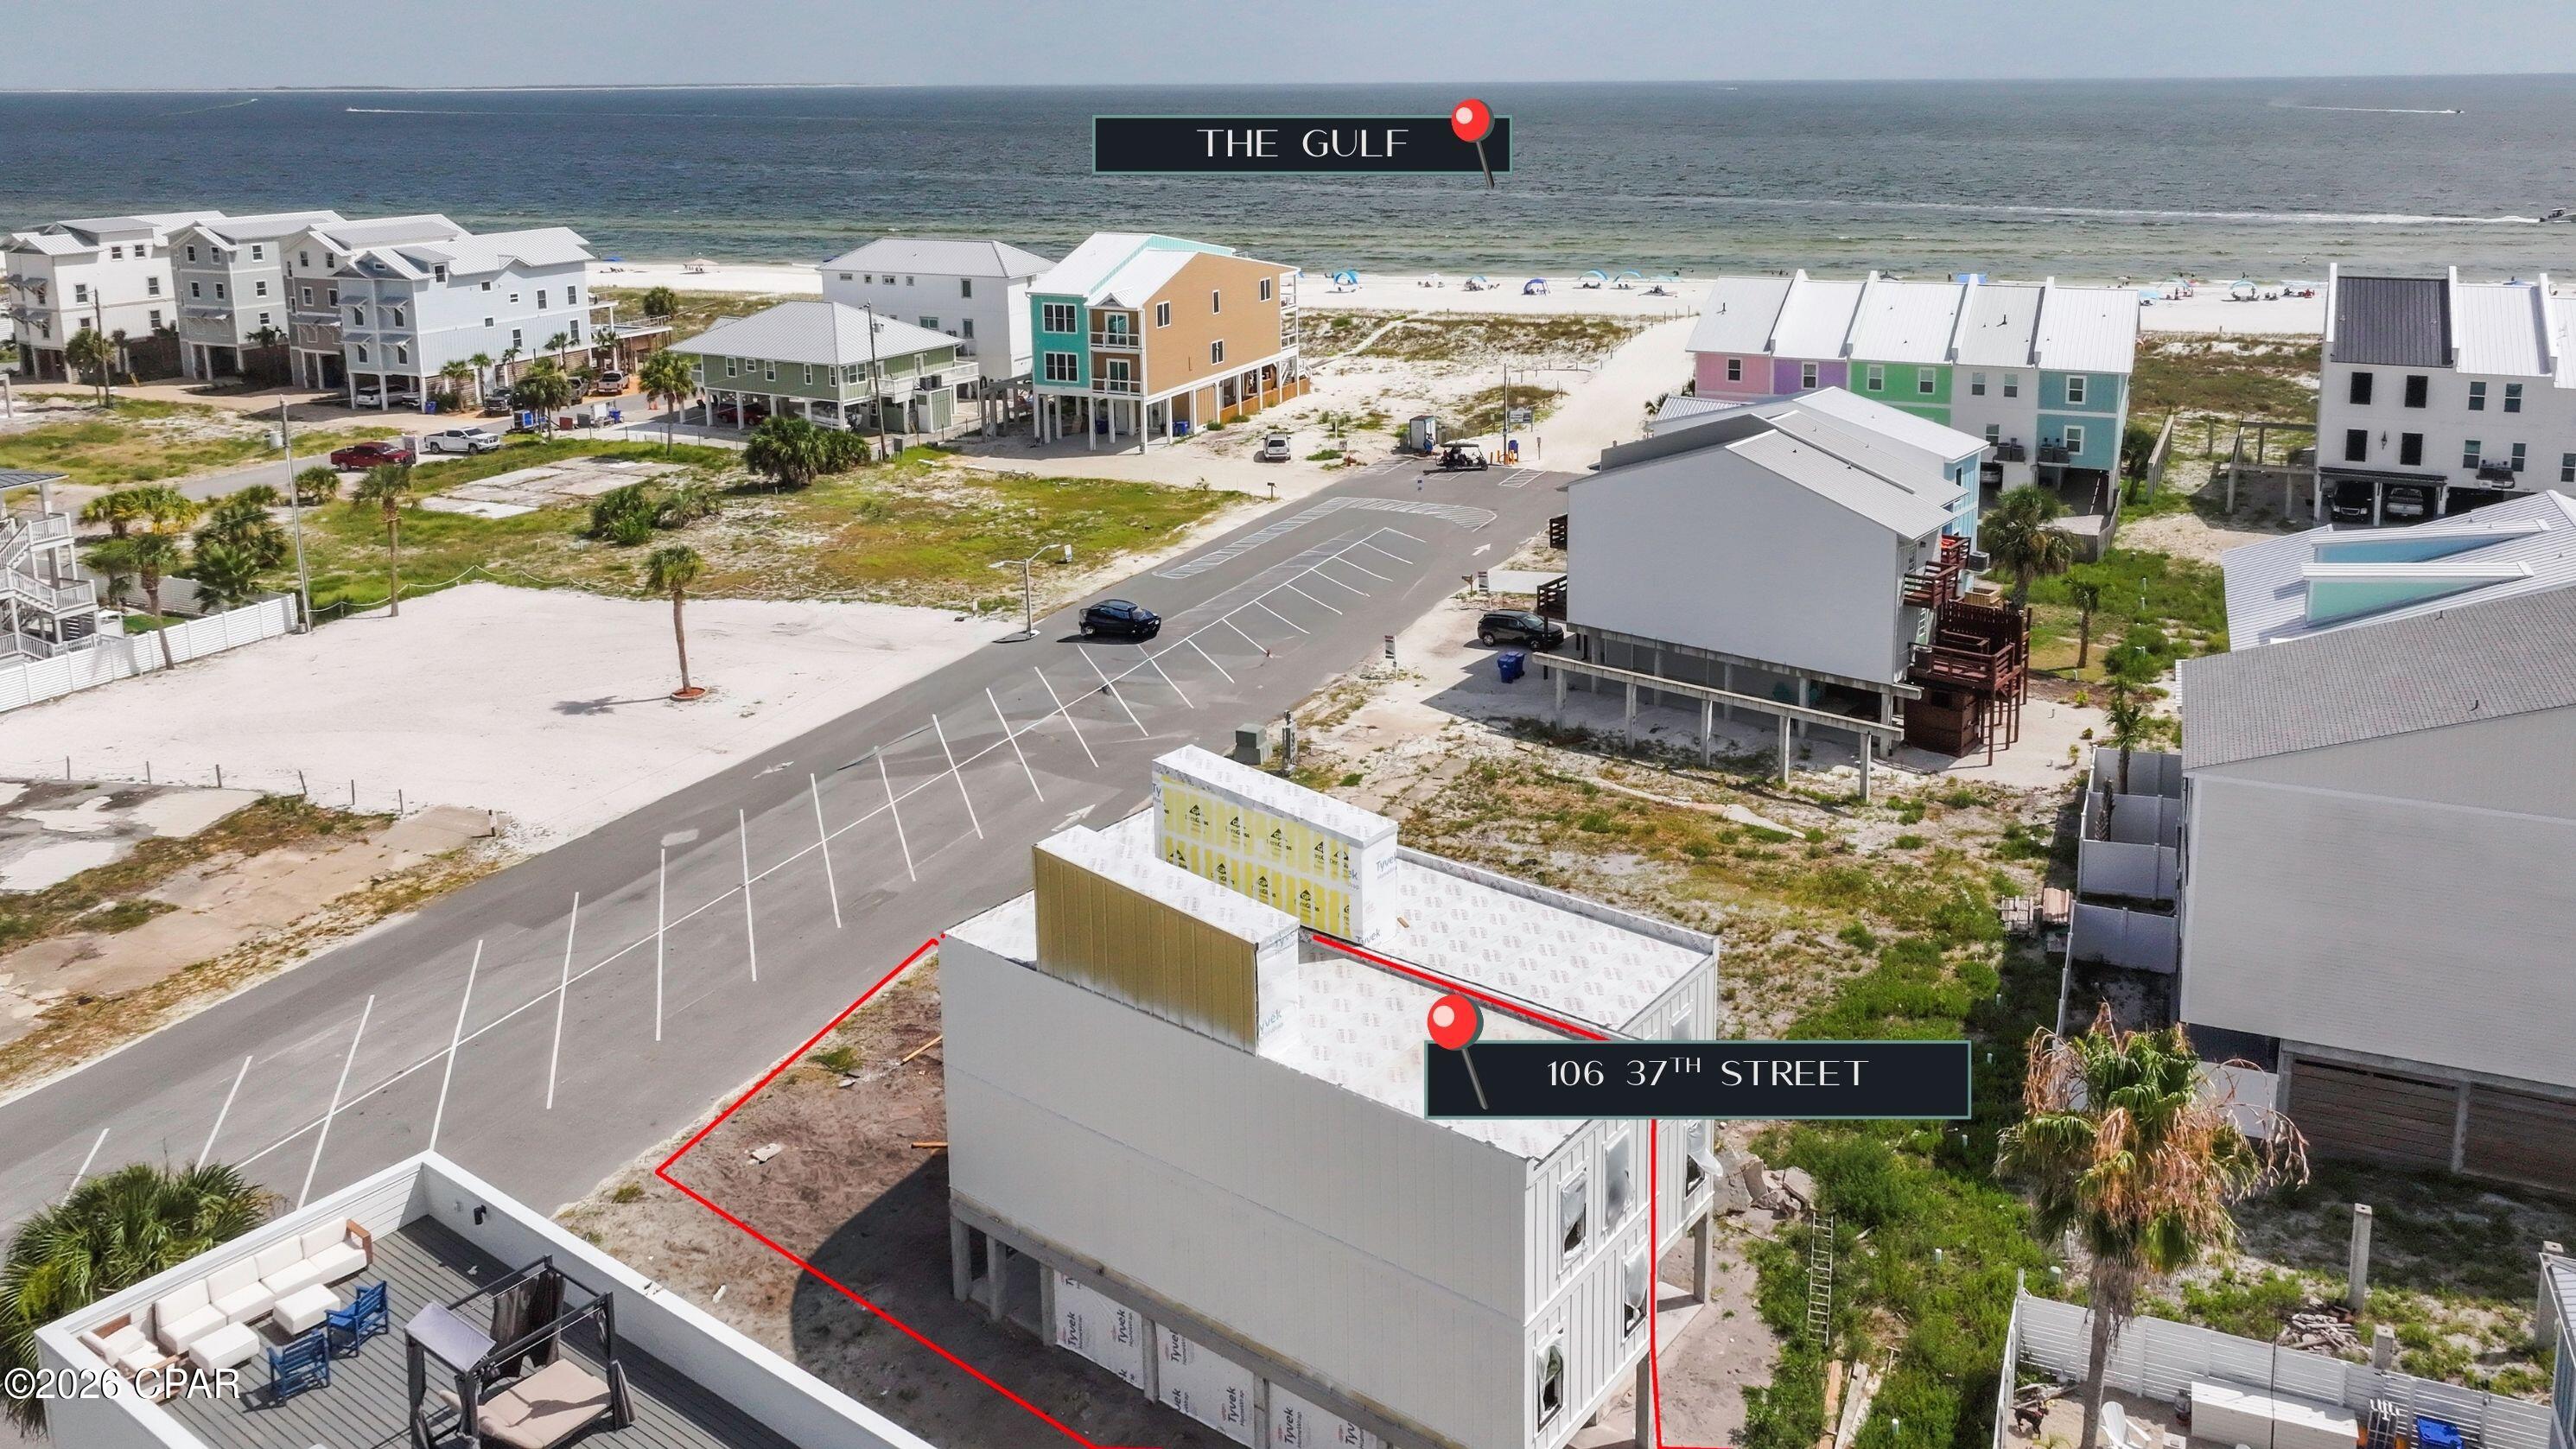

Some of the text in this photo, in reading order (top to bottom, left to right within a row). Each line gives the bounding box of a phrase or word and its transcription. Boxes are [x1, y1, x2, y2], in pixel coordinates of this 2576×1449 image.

[1066, 1312, 1078, 1346] Tyvek
[1116, 1309, 1129, 1344] Tyvek
[1226, 1386, 1239, 1424] Tyvek
[1283, 1407, 1297, 1445] Tyvek
[1345, 1422, 1358, 1446] Tyv
